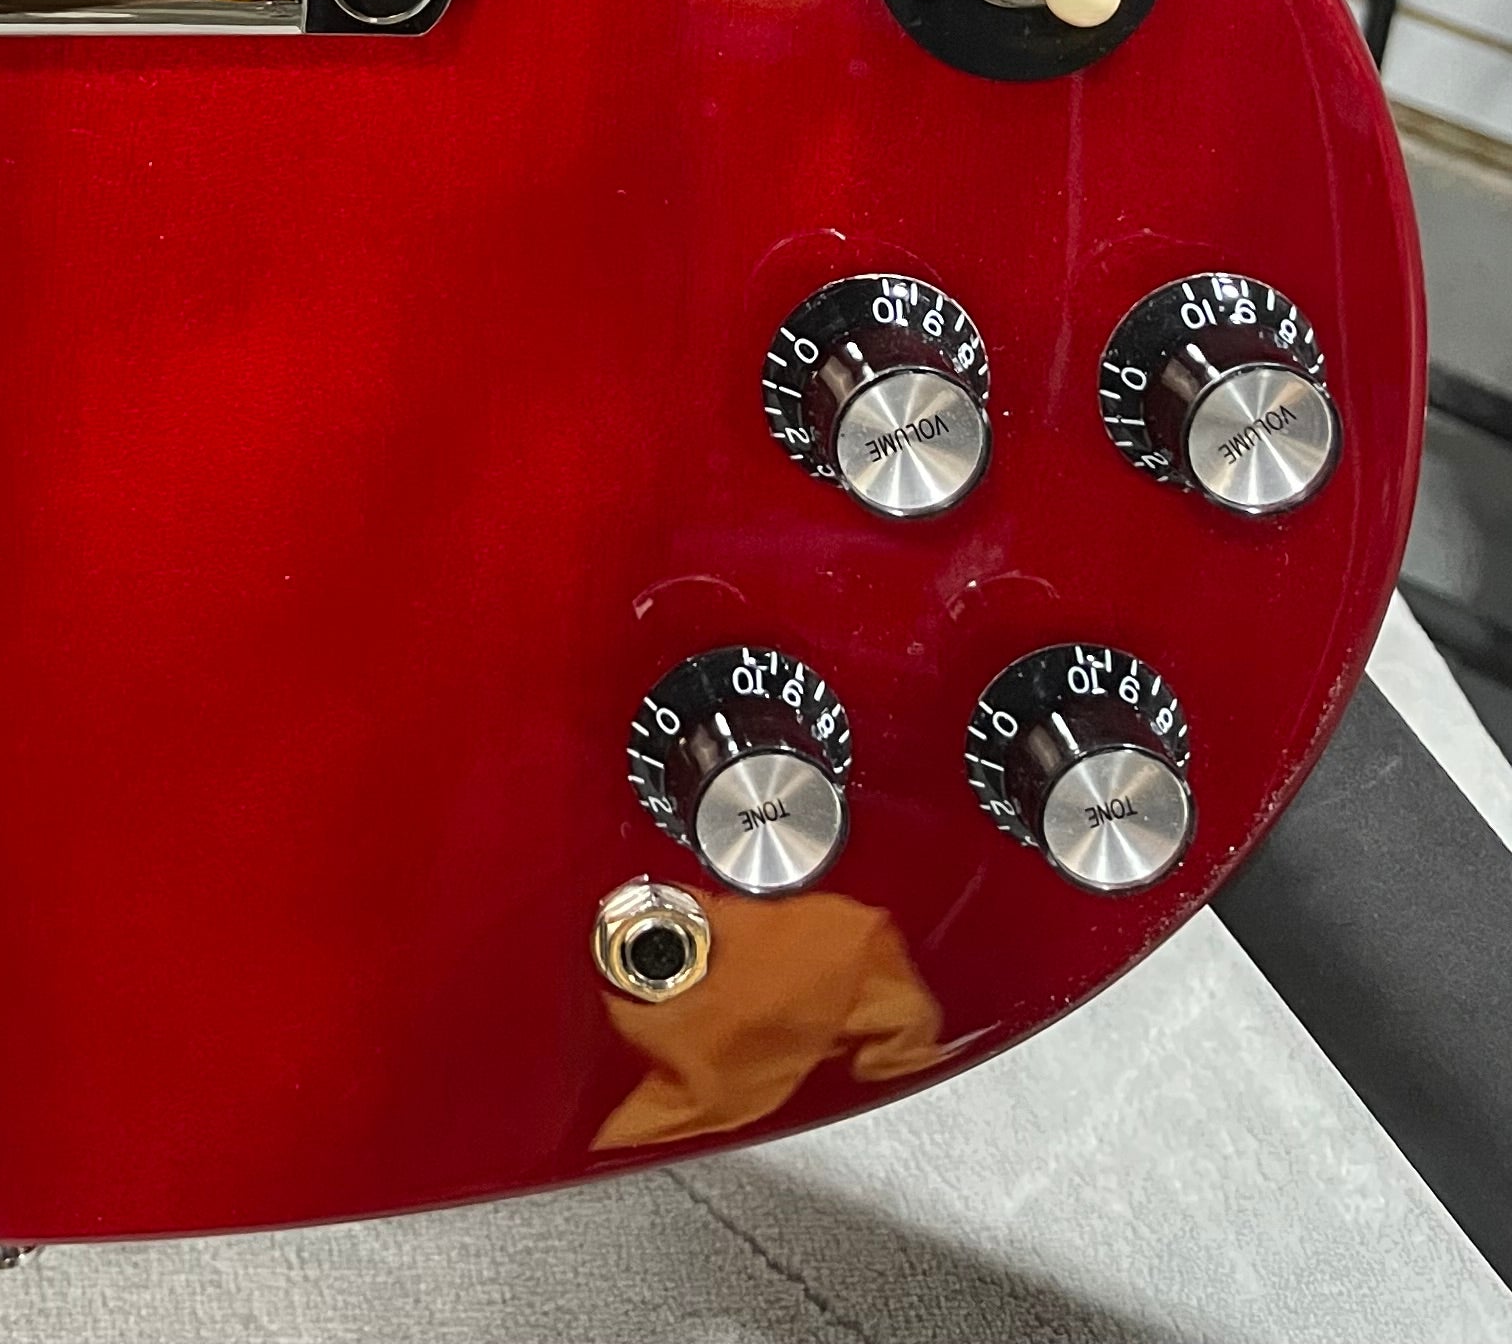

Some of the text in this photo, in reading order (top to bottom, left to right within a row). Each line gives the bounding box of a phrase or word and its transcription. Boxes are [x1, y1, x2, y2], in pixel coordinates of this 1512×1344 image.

[872, 296, 909, 328] 10
[1180, 298, 1218, 330] 10
[793, 338, 819, 363] 0
[1120, 366, 1148, 391] 0
[865, 414, 950, 463] VOLUME
[1218, 404, 1298, 465] VOLUME
[1067, 665, 1107, 695] 10
[655, 707, 681, 735] 0
[991, 710, 1019, 738] 0
[738, 797, 791, 833] TONE
[1084, 795, 1139, 829] TONE
